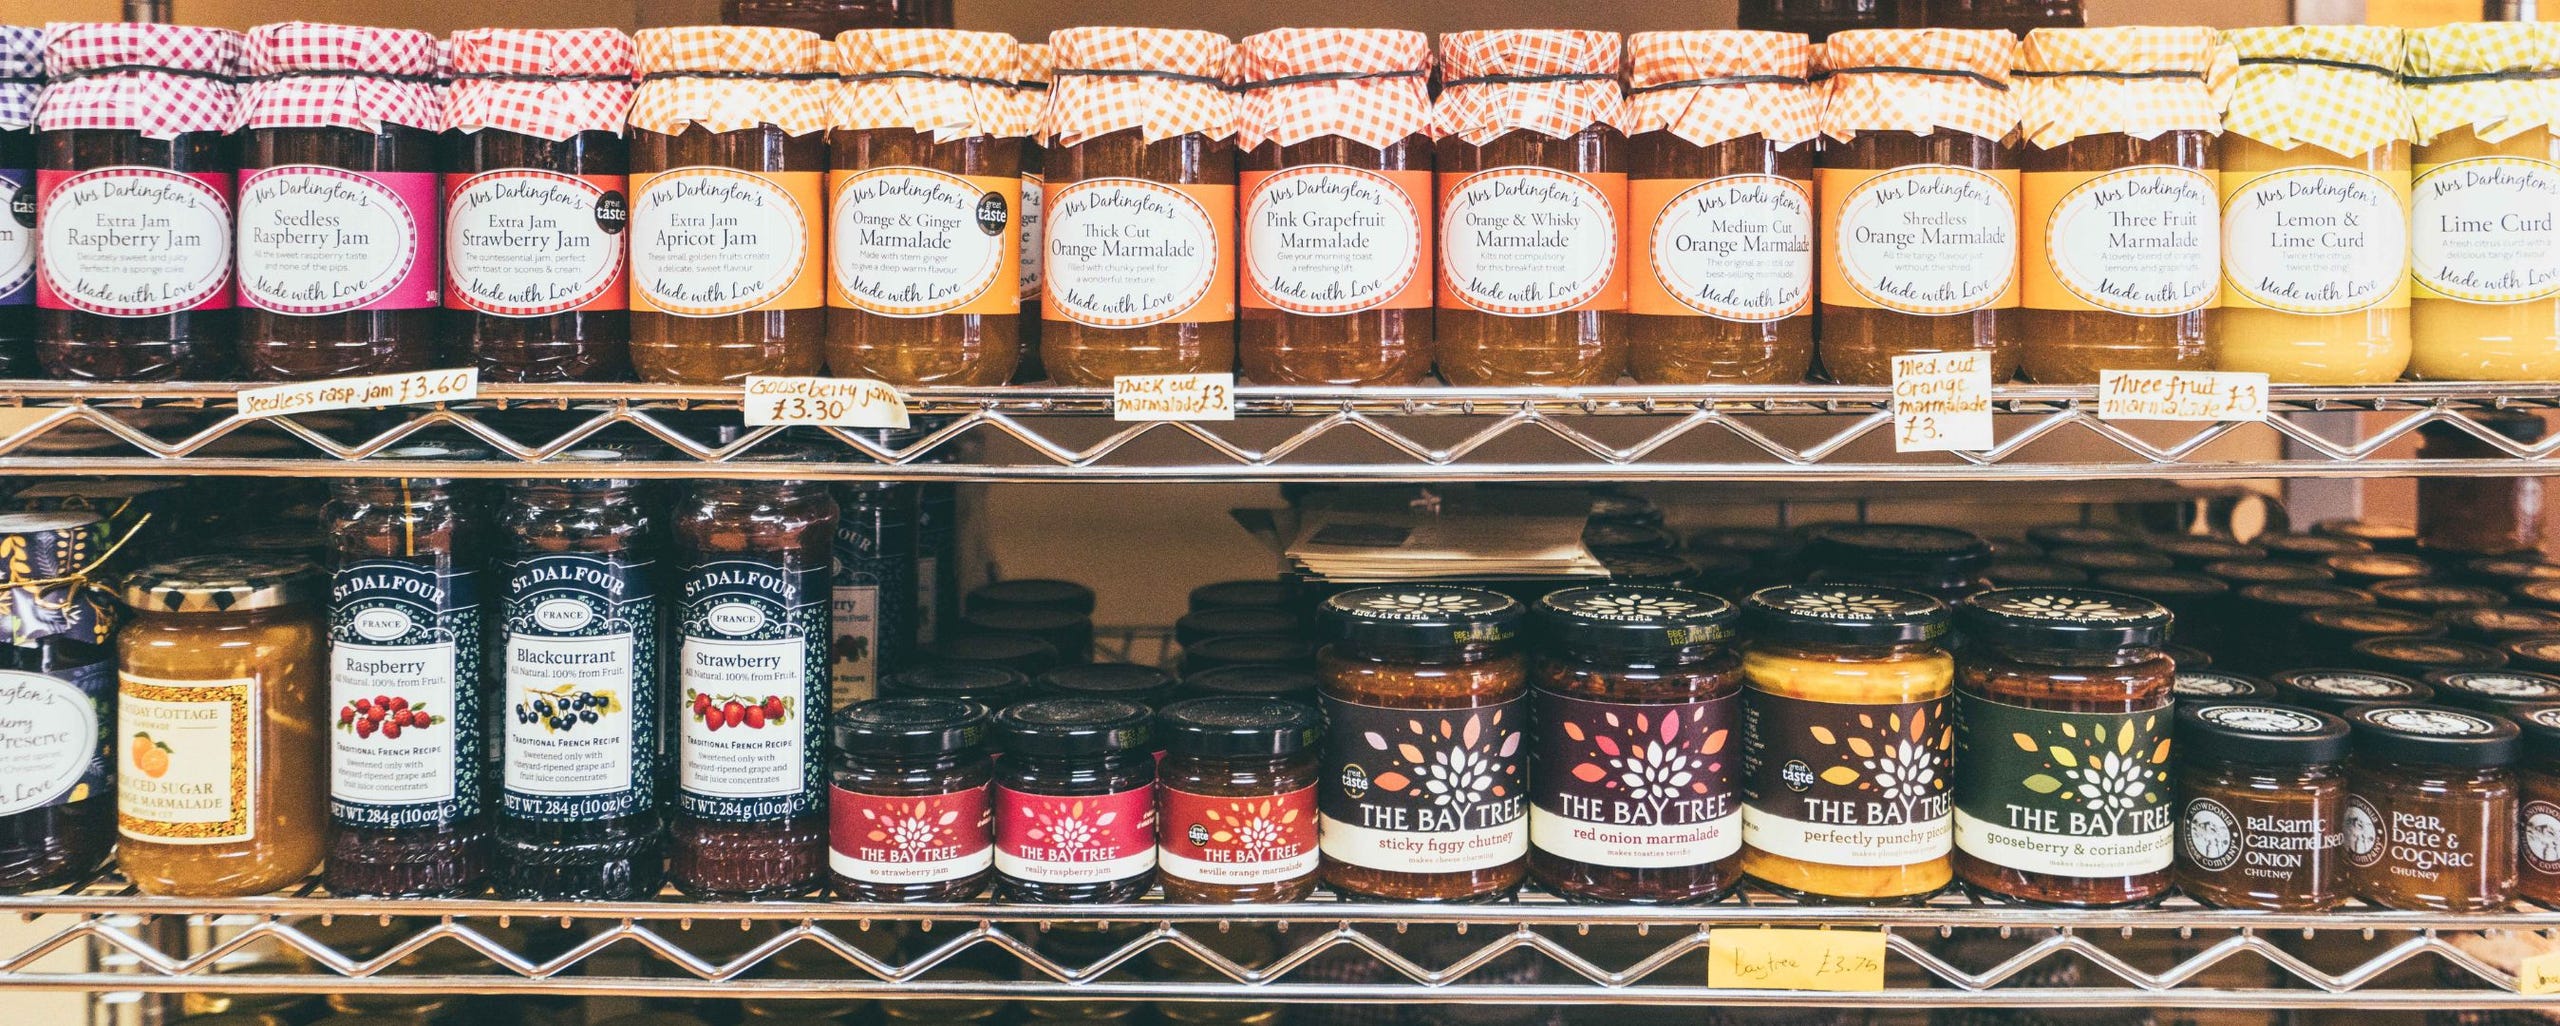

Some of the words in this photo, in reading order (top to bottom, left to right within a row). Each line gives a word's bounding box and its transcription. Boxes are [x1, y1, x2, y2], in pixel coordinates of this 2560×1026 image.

[469, 190, 492, 211] Mrs
[496, 180, 583, 210] Darlington's
[1467, 190, 1492, 209] Mrs
[1495, 178, 1580, 207] Darlington's
[605, 200, 620, 208] great
[1065, 201, 1087, 219] Mrs
[1090, 189, 1175, 219] Darlington's
[96, 213, 135, 227] Extra
[141, 214, 170, 229] Jam
[274, 210, 340, 227] Seedless
[489, 214, 524, 228] Extra
[528, 215, 556, 230] Jam
[597, 207, 626, 220] taste
[671, 213, 705, 227] Extra
[709, 214, 738, 229] Jam
[853, 211, 894, 228] Orange
[899, 215, 912, 226] &
[917, 213, 961, 231] Ginger
[1267, 211, 1297, 227] Pink
[1303, 211, 1385, 229] Grapefruit
[1466, 213, 1509, 229] Orange
[1513, 214, 1525, 226] &
[1531, 213, 1580, 230] Whisky
[1903, 212, 1967, 225] Shredless
[2109, 211, 2157, 226] Three
[2163, 211, 2197, 226] Fruit
[2277, 212, 2336, 226] Lemon
[2344, 212, 2358, 226] &
[2441, 215, 2492, 233] Lime
[2501, 212, 2552, 231] Curd
[1083, 224, 1121, 238] Thick
[1124, 224, 1150, 238] Cut
[1712, 219, 1767, 233] Medium
[1773, 220, 1792, 233] Cut
[68, 228, 160, 252] Raspberry
[166, 229, 201, 250] Jam
[254, 227, 328, 249] Raspberry
[335, 229, 369, 247] Jam
[462, 229, 550, 252] Strawberry
[555, 231, 590, 251] Jam
[656, 230, 716, 251] Apricot
[721, 229, 757, 249] Jam
[860, 229, 952, 249] Marmalade
[1281, 232, 1370, 248] Marmalade
[1476, 231, 1569, 247] Marmalade
[1676, 235, 1737, 257] Orange
[1743, 235, 1809, 252] Marmalade
[1856, 226, 1915, 249] Orange
[1921, 227, 2006, 245] Marmalade
[2109, 232, 2198, 248] Marmalade
[2272, 232, 2315, 247] Lime
[2322, 232, 2364, 247] Curd
[1052, 239, 1097, 262] Orange
[1103, 240, 1194, 257] Marmalade
[655, 278, 688, 301] Made
[691, 283, 727, 302] with
[732, 281, 764, 299] Love
[1270, 276, 1307, 299] Made
[1311, 281, 1345, 300] with
[1351, 279, 1382, 297] Love
[1946, 357, 1979, 373] cut
[363, 381, 394, 402] jam
[1170, 376, 1198, 391] cut
[1897, 379, 1965, 399] Orange
[2110, 374, 2162, 394] Three
[2165, 376, 2221, 401] fruit
[750, 379, 857, 405] Gooseberry
[861, 384, 899, 407] jam
[772, 398, 844, 421] £3.30
[1117, 396, 1201, 413] marmalade
[1898, 395, 1987, 415] marmalade
[2105, 399, 2221, 417] marmalade
[532, 566, 625, 595] DALFOUR
[705, 570, 796, 600] DALFOUR
[351, 575, 445, 605] DALFOUR
[362, 620, 401, 628] FRANCE
[543, 611, 583, 619] FRANCE
[717, 615, 756, 623] FRANCE
[517, 648, 616, 664] Blackcurrant
[696, 652, 781, 670] Strawberry
[347, 658, 426, 676] Raspberry
[552, 669, 577, 678] 100%
[578, 669, 601, 678] from
[154, 707, 218, 720] COTTAGE
[558, 738, 590, 747] FRENCH
[593, 736, 620, 745] RECIPE
[161, 783, 213, 794] SUGAR
[142, 797, 223, 809] MARMALADE
[504, 793, 521, 810] NET
[522, 799, 543, 814] WT.
[545, 801, 569, 815] 284
[570, 803, 579, 817] g
[1560, 793, 1605, 822] THE
[1614, 794, 1670, 825] BAY
[1674, 795, 1728, 824] TREE
[1360, 804, 1409, 831] THE
[1419, 800, 1472, 832] BAY
[1476, 797, 1520, 827] TREE
[1379, 838, 1424, 854] sticky
[1429, 839, 1465, 854] figgy
[1468, 831, 1513, 850] chutney
[1574, 828, 1595, 841] red
[1600, 832, 1643, 845] onion
[1647, 826, 1719, 845] marmalade
[1804, 829, 1872, 847] perfectly
[1877, 829, 1924, 847] punchy
[1987, 832, 2069, 857] gooseberry
[2073, 844, 2085, 855] &
[2089, 841, 2153, 856] coriander
[2447, 834, 2459, 849] &
[2245, 851, 2302, 867] ONION
[881, 868, 931, 877] strawberry
[932, 867, 949, 875] jam
[1025, 866, 1048, 876] really
[1049, 868, 1093, 877] raspberry
[1096, 867, 1111, 875] jam
[1200, 867, 1227, 876] seville
[1229, 869, 1260, 878] orange
[1262, 862, 1302, 875] marmalade
